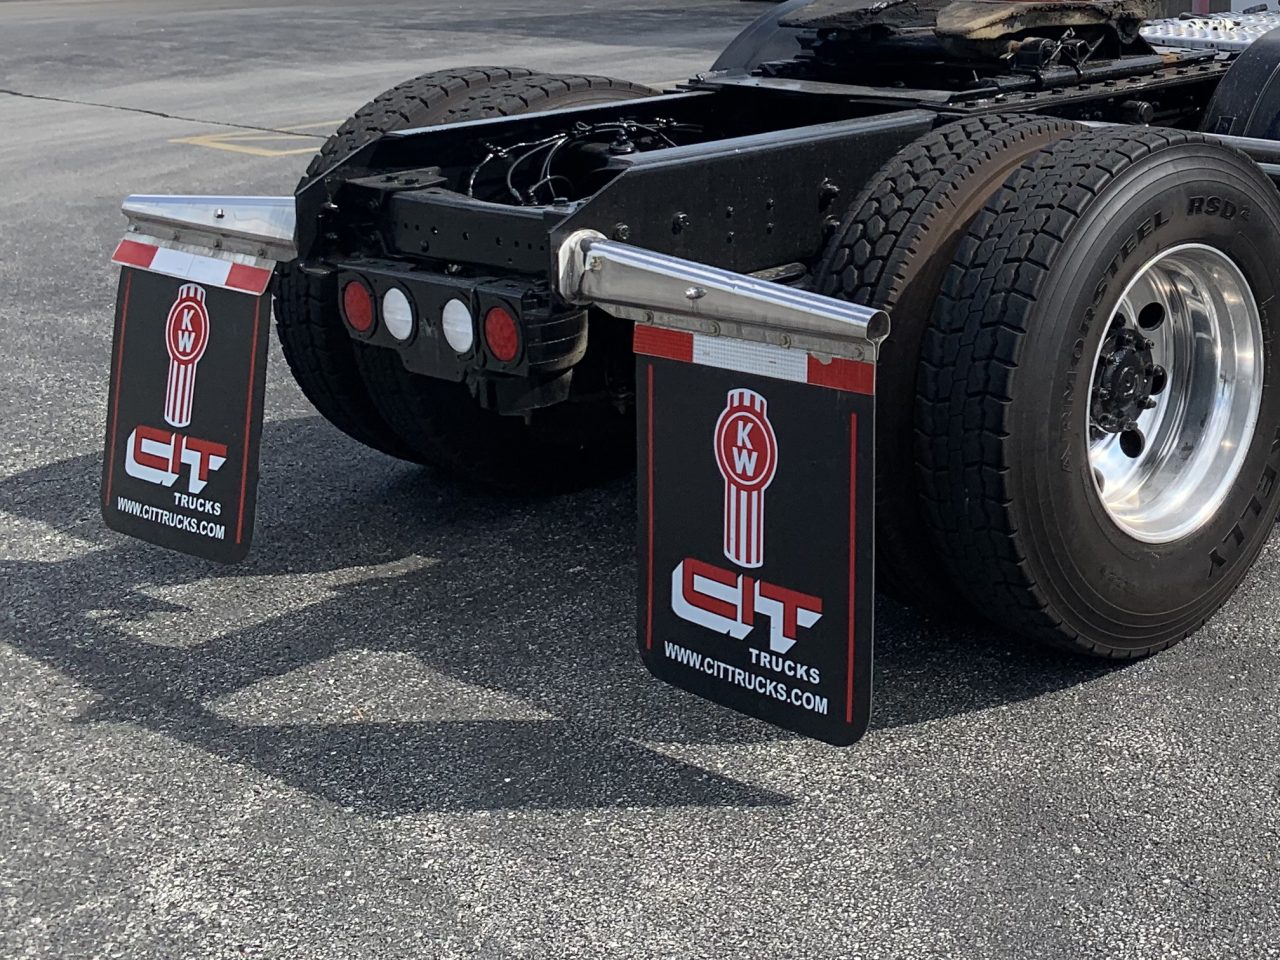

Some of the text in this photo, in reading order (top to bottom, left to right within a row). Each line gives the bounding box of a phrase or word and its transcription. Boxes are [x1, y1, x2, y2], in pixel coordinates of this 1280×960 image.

[124, 424, 228, 495] CIT
[117, 495, 226, 541] WWW.CITTRUCKS.COM
[173, 491, 222, 517] TRUCKS
[671, 557, 823, 655] CIT
[664, 640, 829, 716] WWW.CITTRUCKS.COM
[748, 647, 821, 685] TRUCKS
